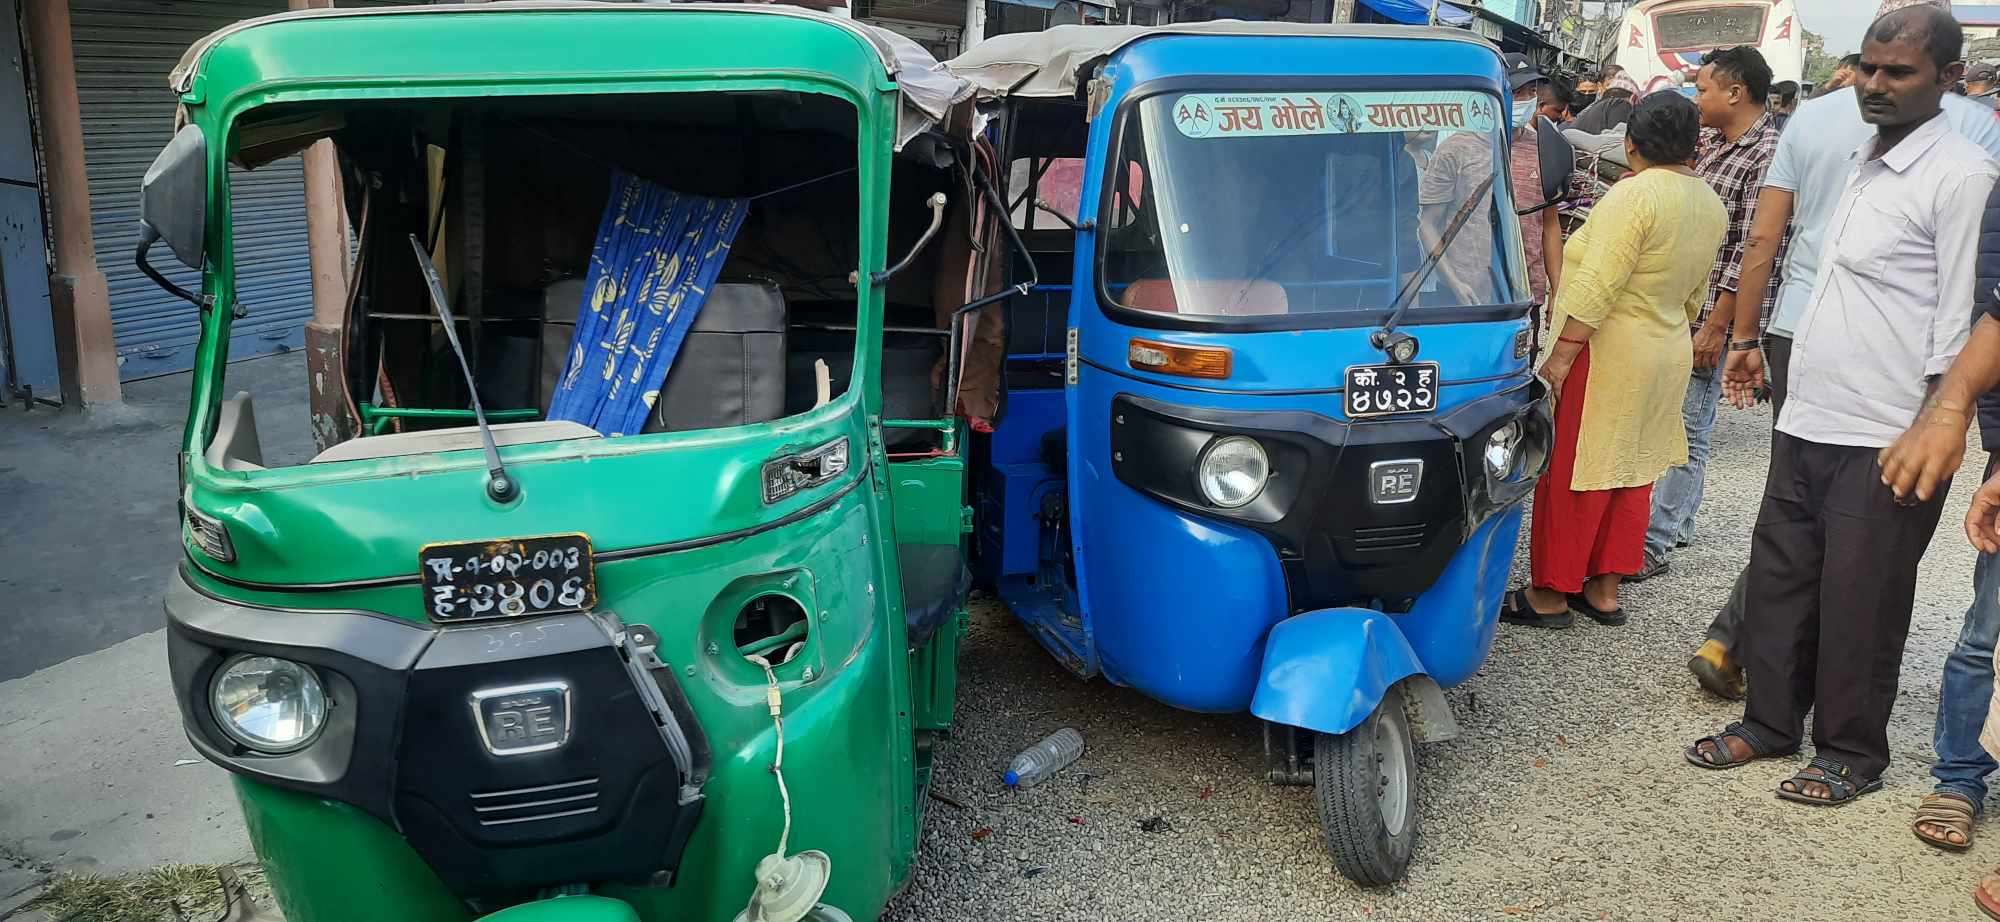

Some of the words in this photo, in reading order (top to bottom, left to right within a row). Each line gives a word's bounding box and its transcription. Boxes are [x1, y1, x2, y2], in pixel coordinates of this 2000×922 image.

[1214, 106, 1263, 132] जय
[1269, 97, 1325, 131] भोले
[1365, 102, 1465, 128] यातायात
[1395, 371, 1405, 386] २
[1418, 369, 1433, 387] ह
[1352, 387, 1432, 412] ४७२२
[1381, 474, 1413, 495] RE
[493, 705, 555, 741] RE
